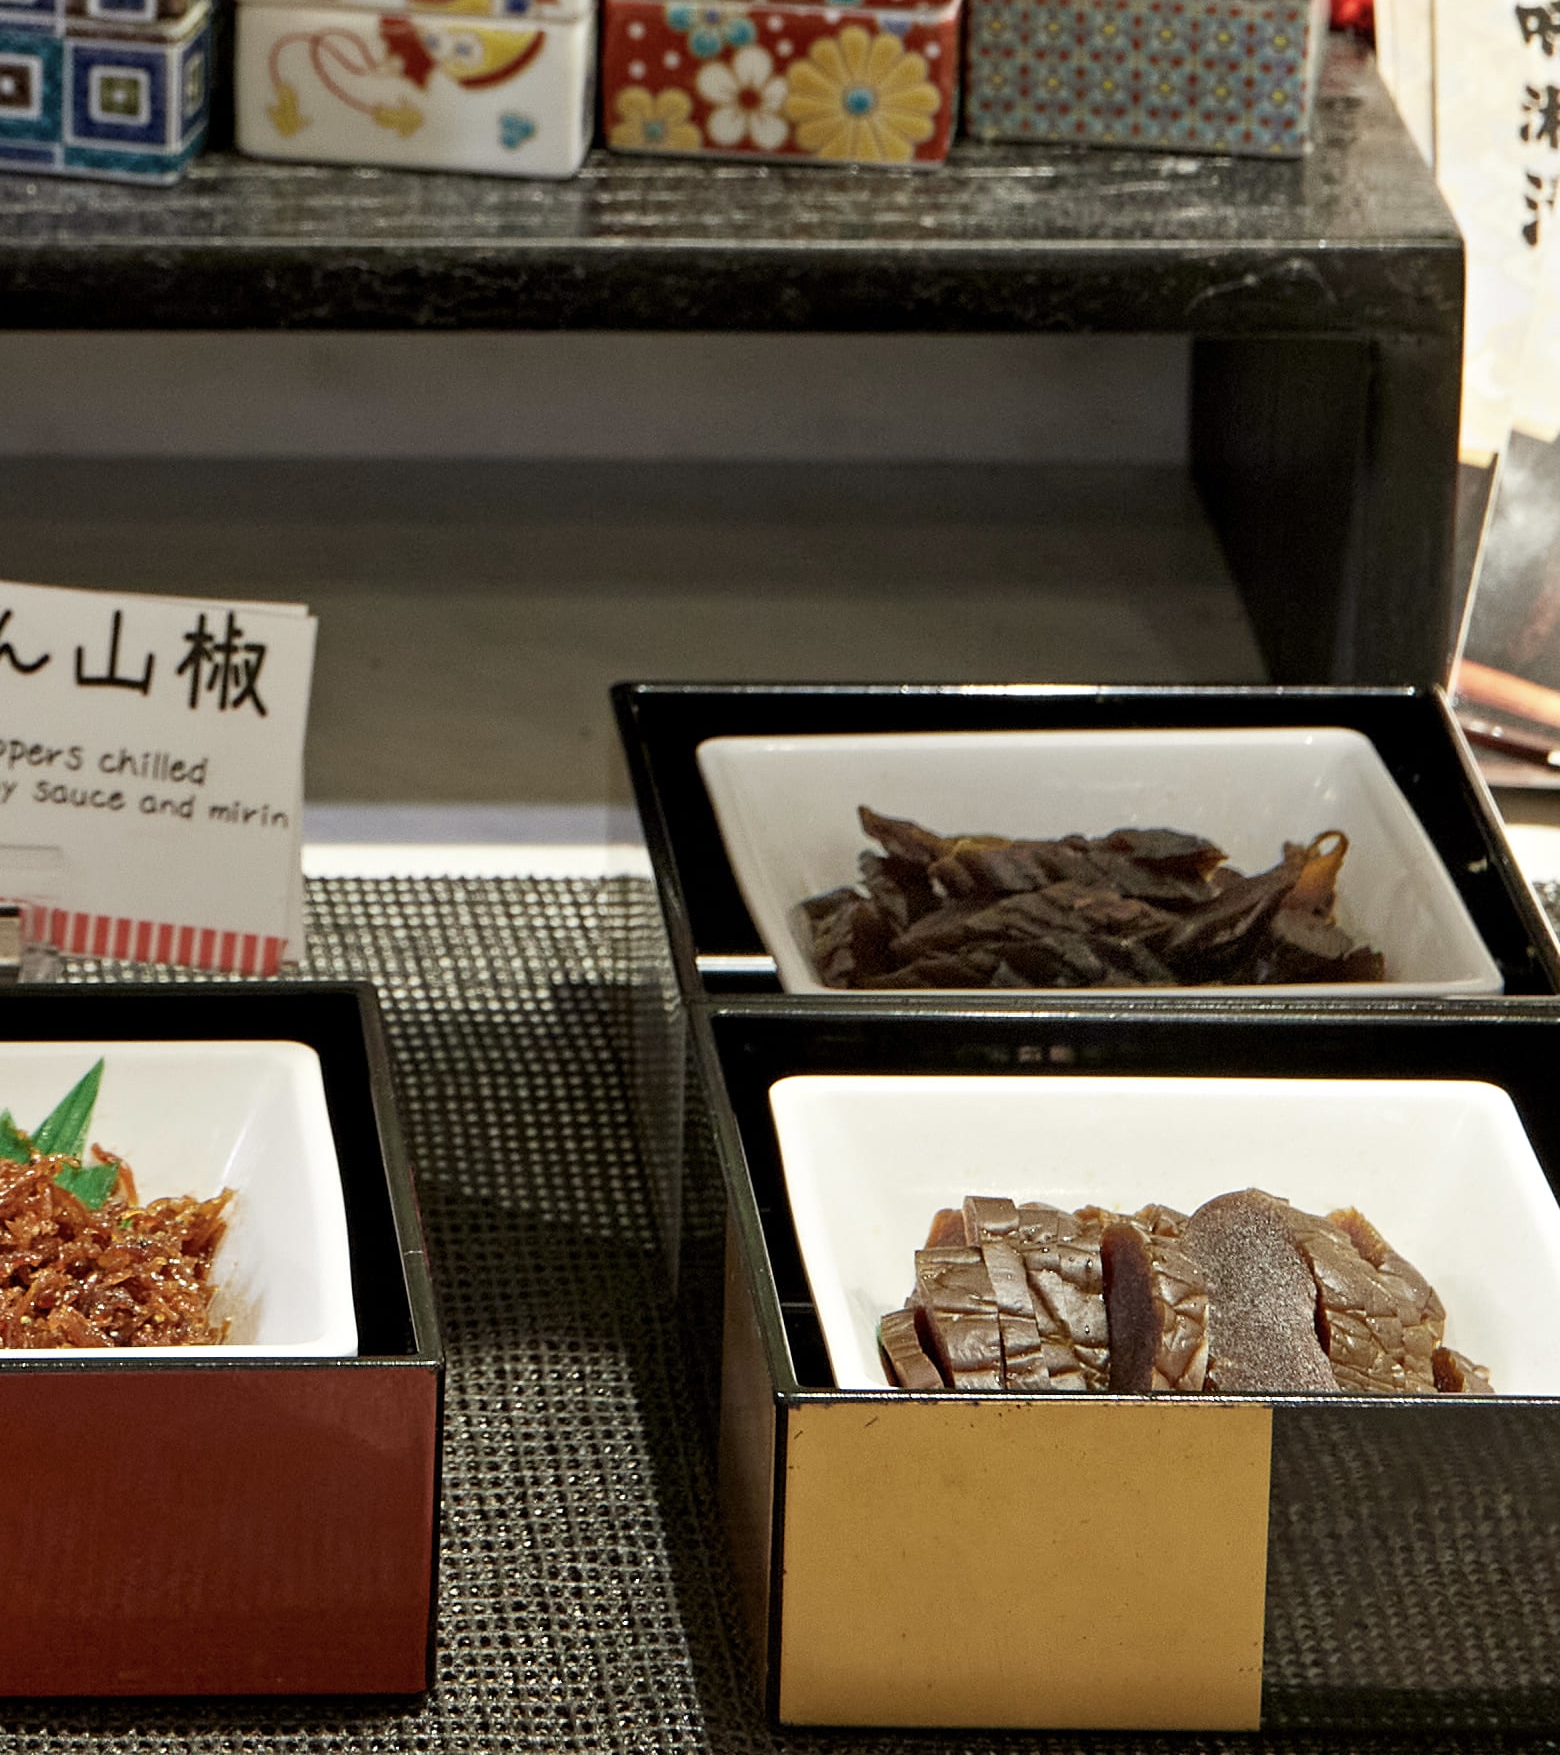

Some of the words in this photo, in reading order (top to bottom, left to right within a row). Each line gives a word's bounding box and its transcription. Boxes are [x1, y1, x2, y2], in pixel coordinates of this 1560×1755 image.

[98, 748, 210, 786] chilled
[31, 780, 127, 813] sauce
[138, 794, 195, 822] and
[208, 801, 290, 830] mirin
